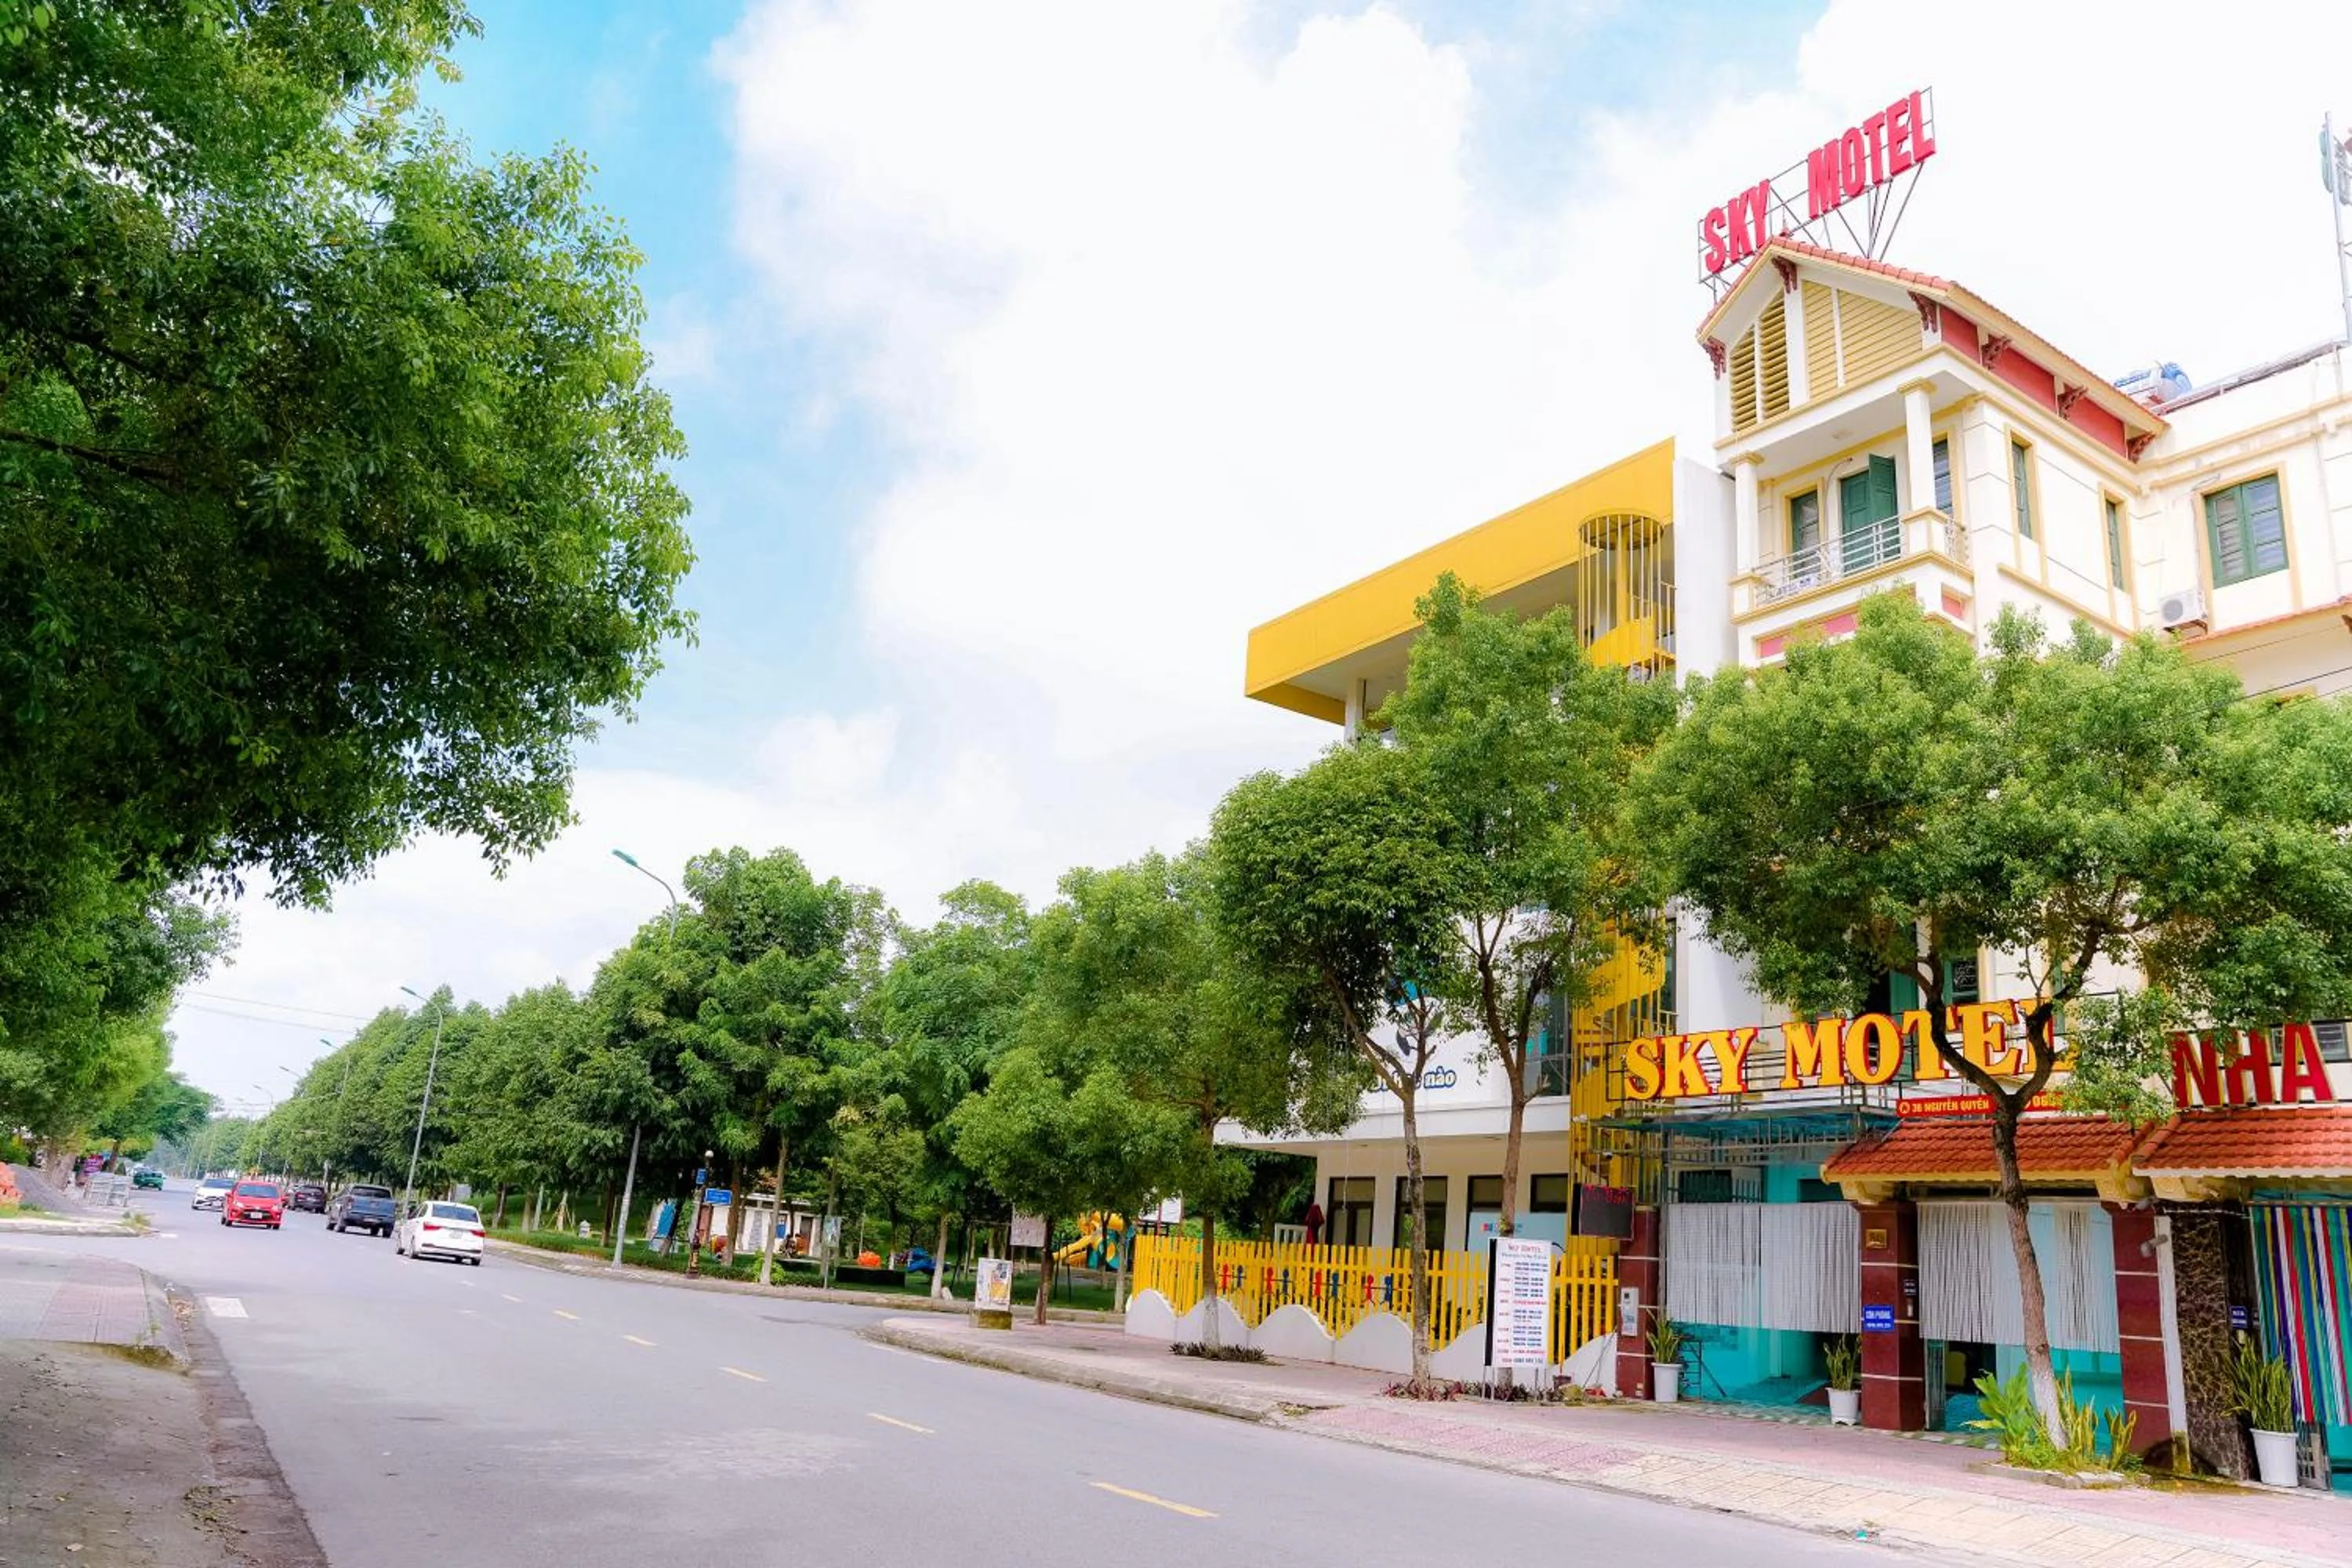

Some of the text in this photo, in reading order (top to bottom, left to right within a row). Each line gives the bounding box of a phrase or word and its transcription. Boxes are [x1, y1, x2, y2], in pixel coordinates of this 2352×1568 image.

[1704, 89, 1936, 274] SKY MOTEL
[1623, 1028, 1758, 1101] SKY
